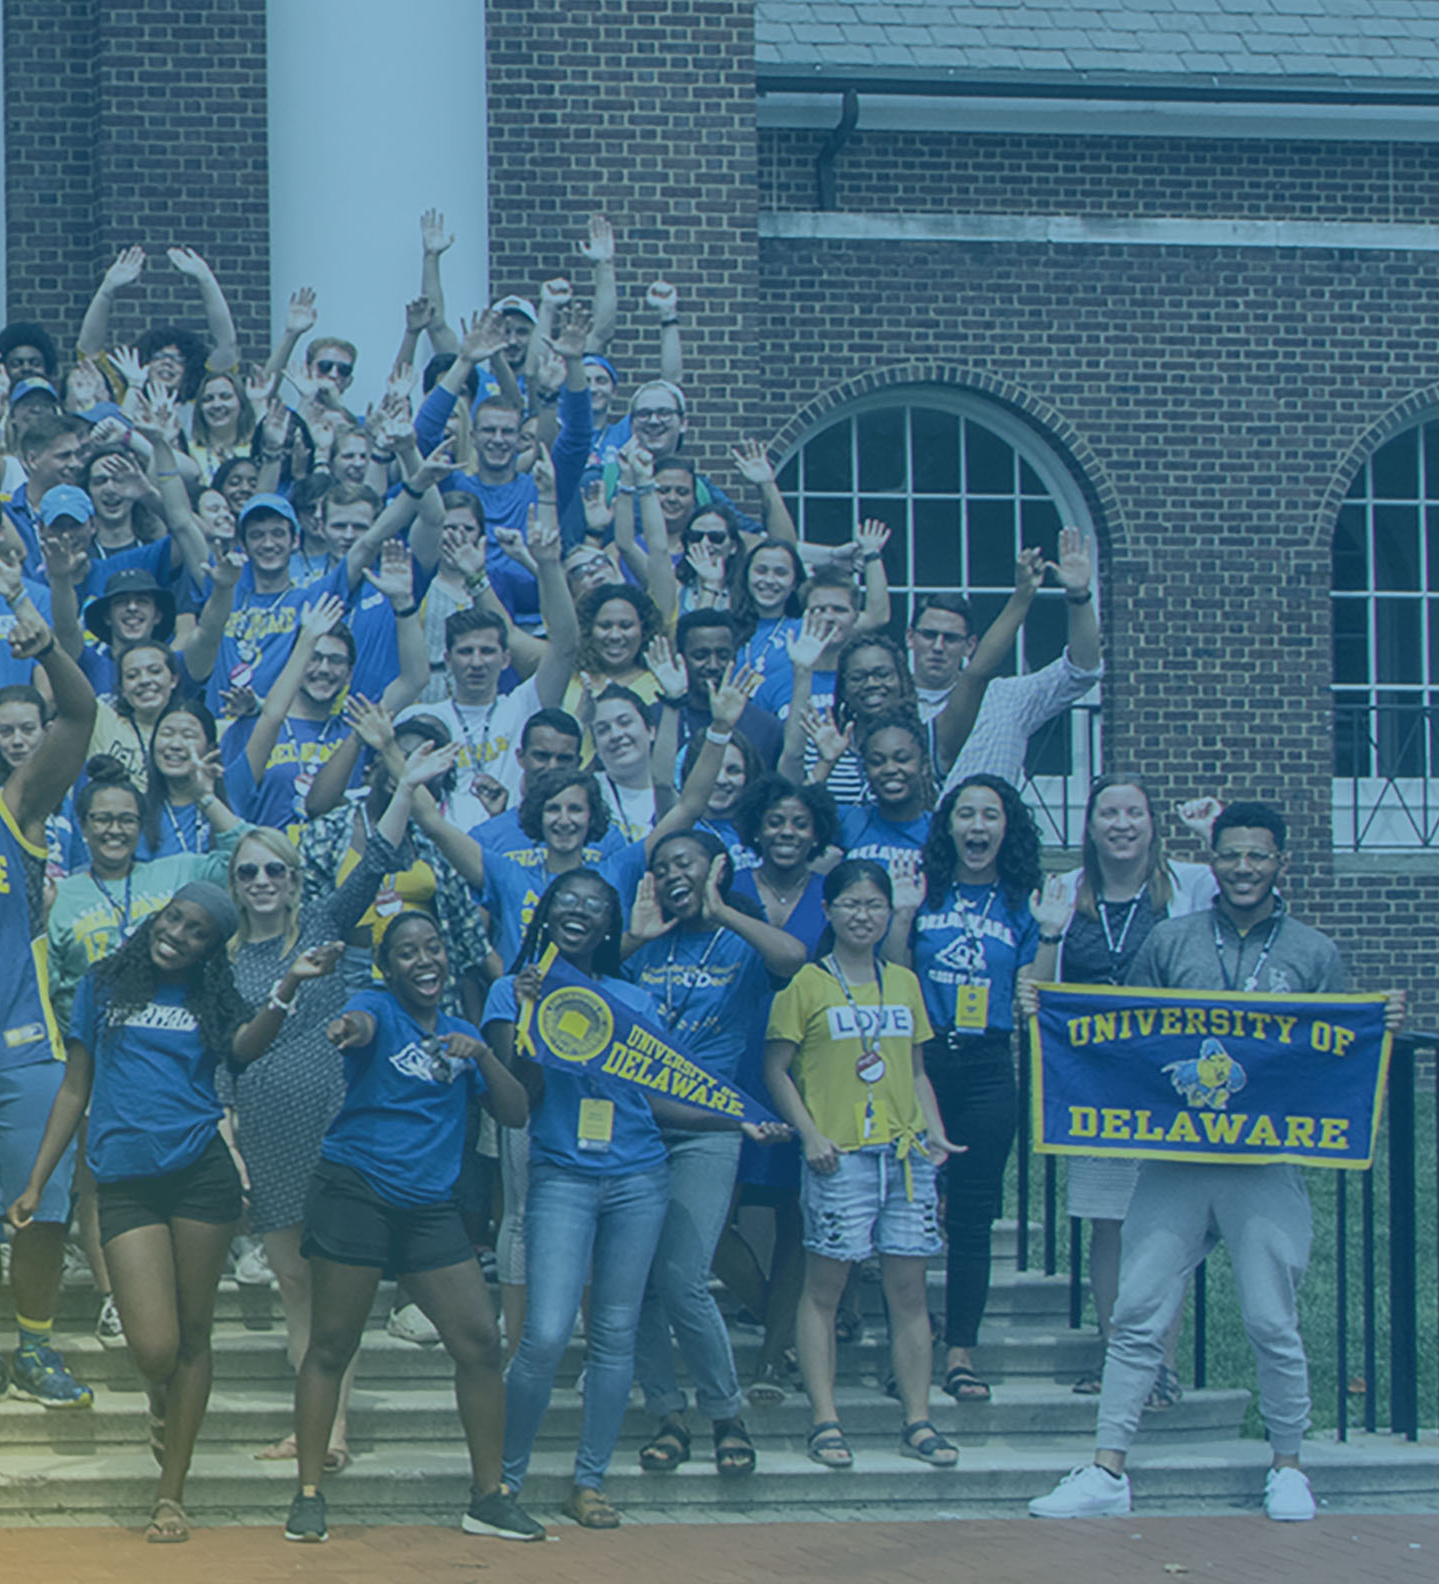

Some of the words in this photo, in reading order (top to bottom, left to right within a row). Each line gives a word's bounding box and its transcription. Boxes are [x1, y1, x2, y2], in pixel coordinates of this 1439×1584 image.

[836, 1008, 909, 1033] LOVE
[1067, 1006, 1298, 1047] UNIVERSITY
[1310, 1019, 1355, 1057] OF
[601, 1041, 745, 1118] DELAWARE
[626, 1024, 717, 1089] UNIVERSITY
[1067, 1104, 1350, 1151] DELAWARE
